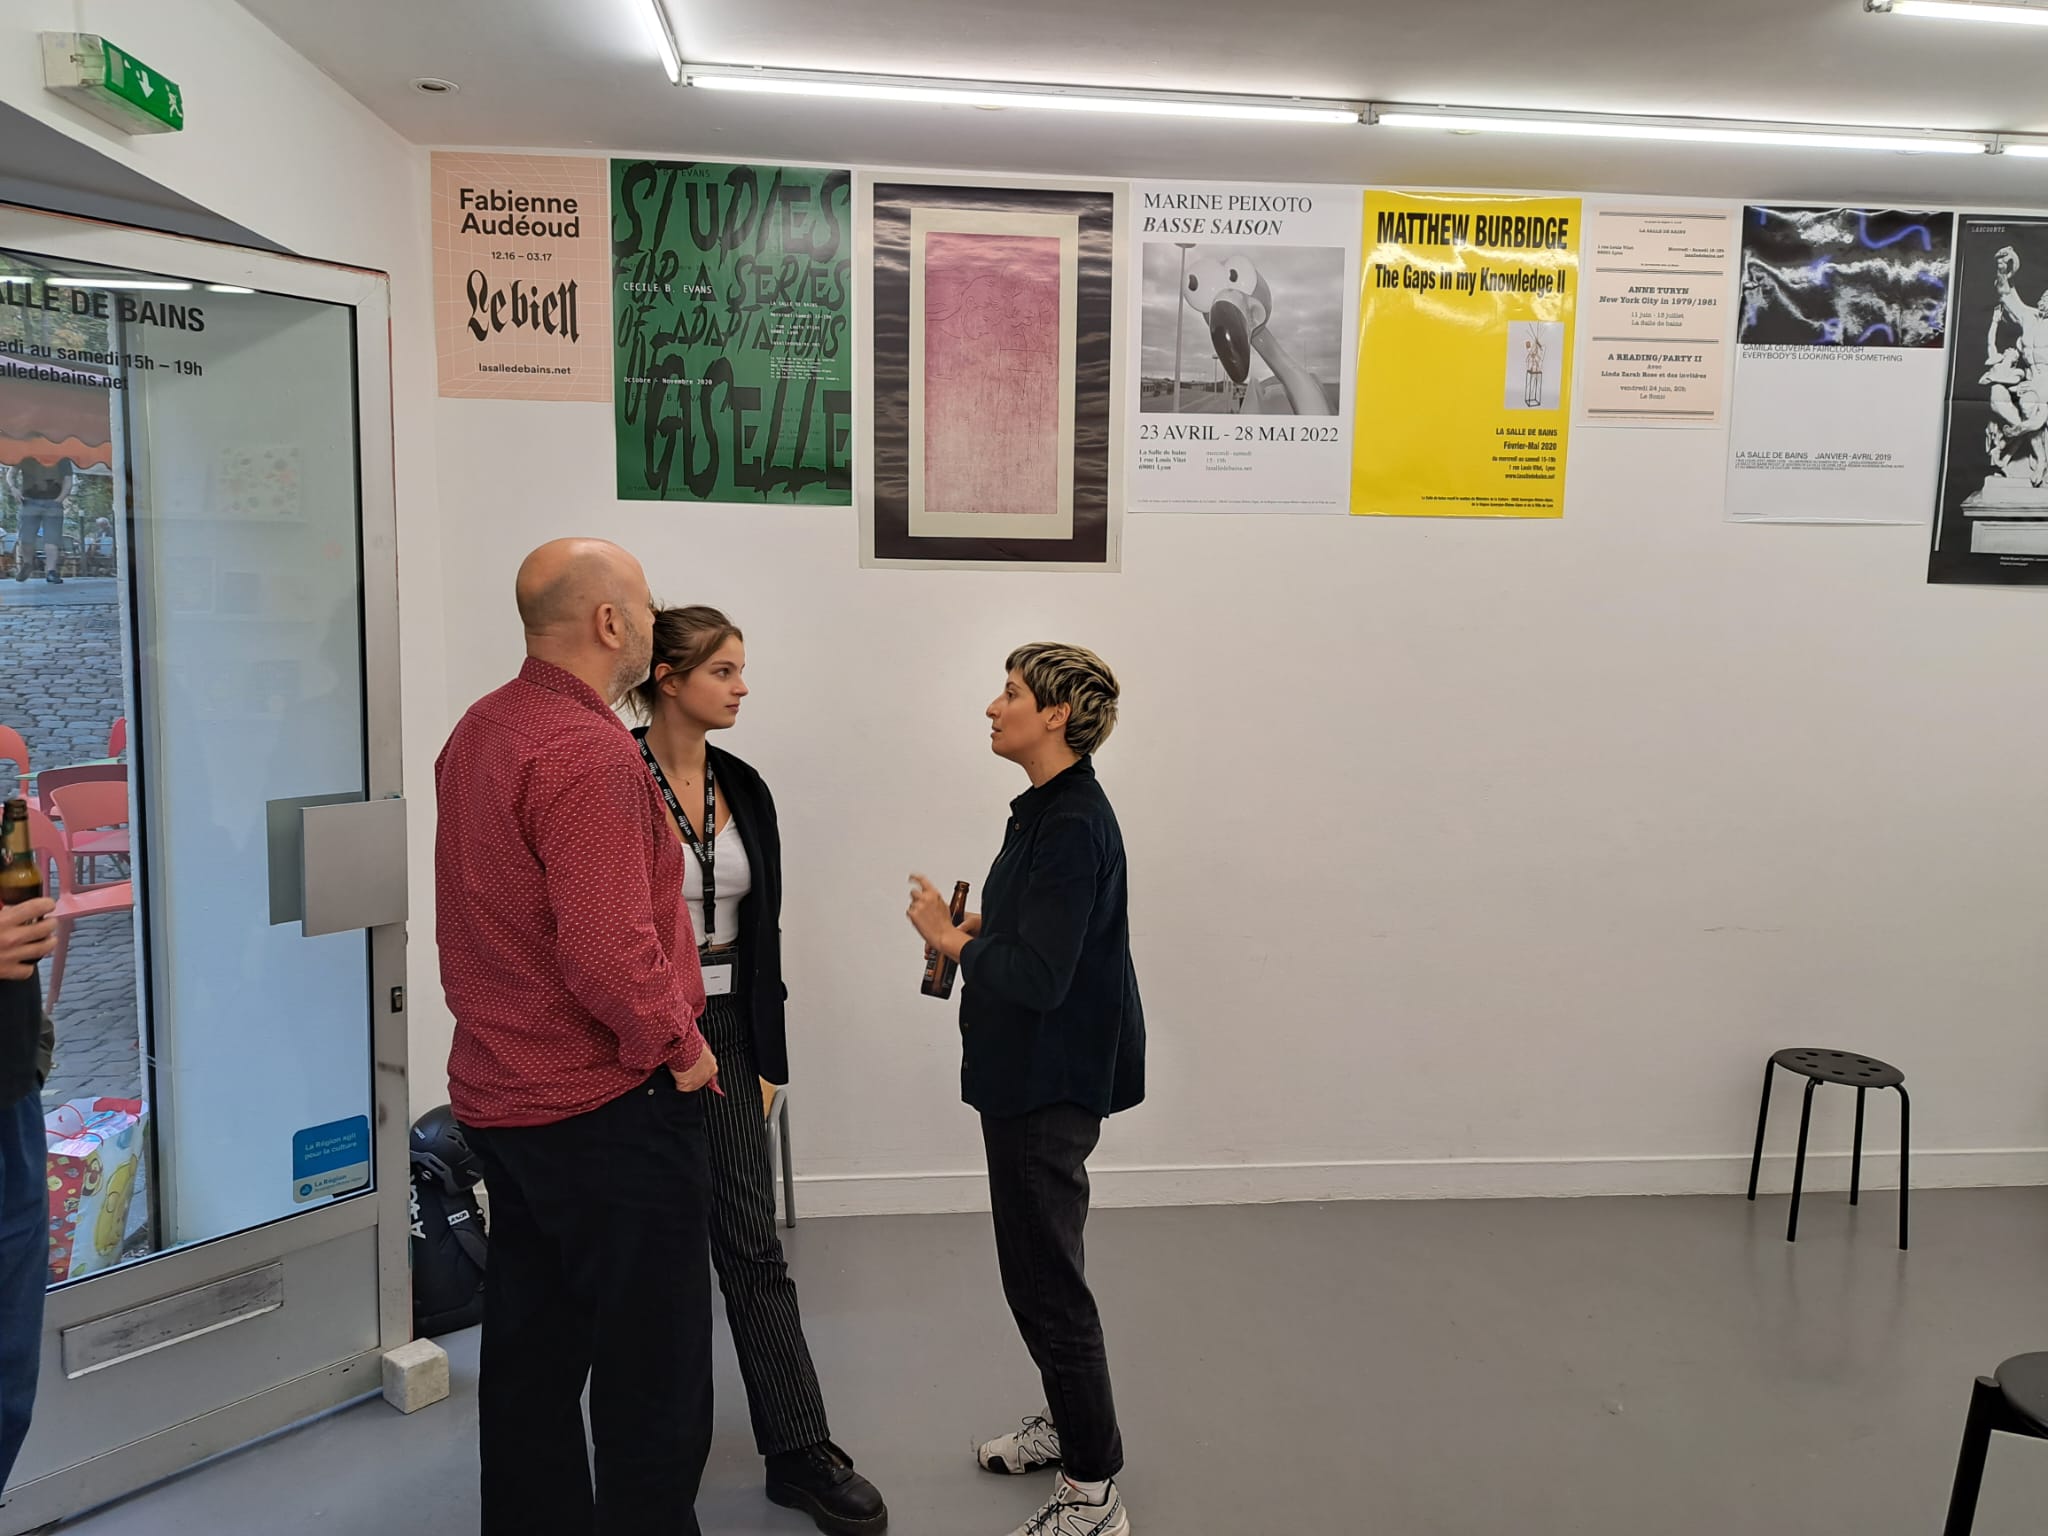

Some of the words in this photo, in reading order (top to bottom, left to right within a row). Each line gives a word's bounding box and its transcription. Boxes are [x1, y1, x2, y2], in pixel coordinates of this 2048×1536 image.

[460, 189, 579, 213] Fabienne
[1144, 193, 1223, 211] MARINE
[1229, 195, 1313, 213] PEIXOTO
[461, 213, 580, 238] Audéoud
[1143, 217, 1207, 235] BASSE
[1210, 219, 1284, 236] SAISON
[1377, 212, 1470, 245] MATTHEW
[1475, 215, 1569, 249] BURBIDGE
[492, 251, 515, 260] 12.16
[527, 253, 552, 262] 03.17
[1376, 264, 1398, 288] The
[1404, 265, 1436, 294] Gaps
[1440, 267, 1453, 290] in
[1457, 271, 1477, 296] my
[1481, 267, 1554, 298] Knowledge
[623, 282, 659, 293] CECILE
[683, 285, 713, 295] EVANS
[1628, 286, 1655, 294] ANNE
[1641, 297, 1658, 306] City
[1671, 298, 1717, 307] 1979/1981
[71, 288, 110, 320] DE
[120, 293, 205, 333] BAINS
[31, 344, 51, 358] au
[58, 347, 120, 367] samedi
[124, 354, 154, 370] 15h
[175, 360, 202, 377] 19h
[1617, 354, 1692, 362] READING/PARTY
[1742, 352, 1797, 360] EVERYBODY'S
[1799, 353, 1836, 361] LOOKING
[1856, 354, 1903, 362] SOMETHING
[479, 363, 571, 375] lasalledebains.net
[623, 376, 651, 384] Octobre
[662, 378, 693, 386] Novembre
[1140, 424, 1159, 440] 23
[1163, 425, 1220, 441] AVRIL
[1234, 427, 1254, 441] 28
[1258, 427, 1296, 442] MAI
[1300, 427, 1339, 442] 2022
[1506, 428, 1526, 436] SALLE
[1541, 442, 1557, 450] 2020
